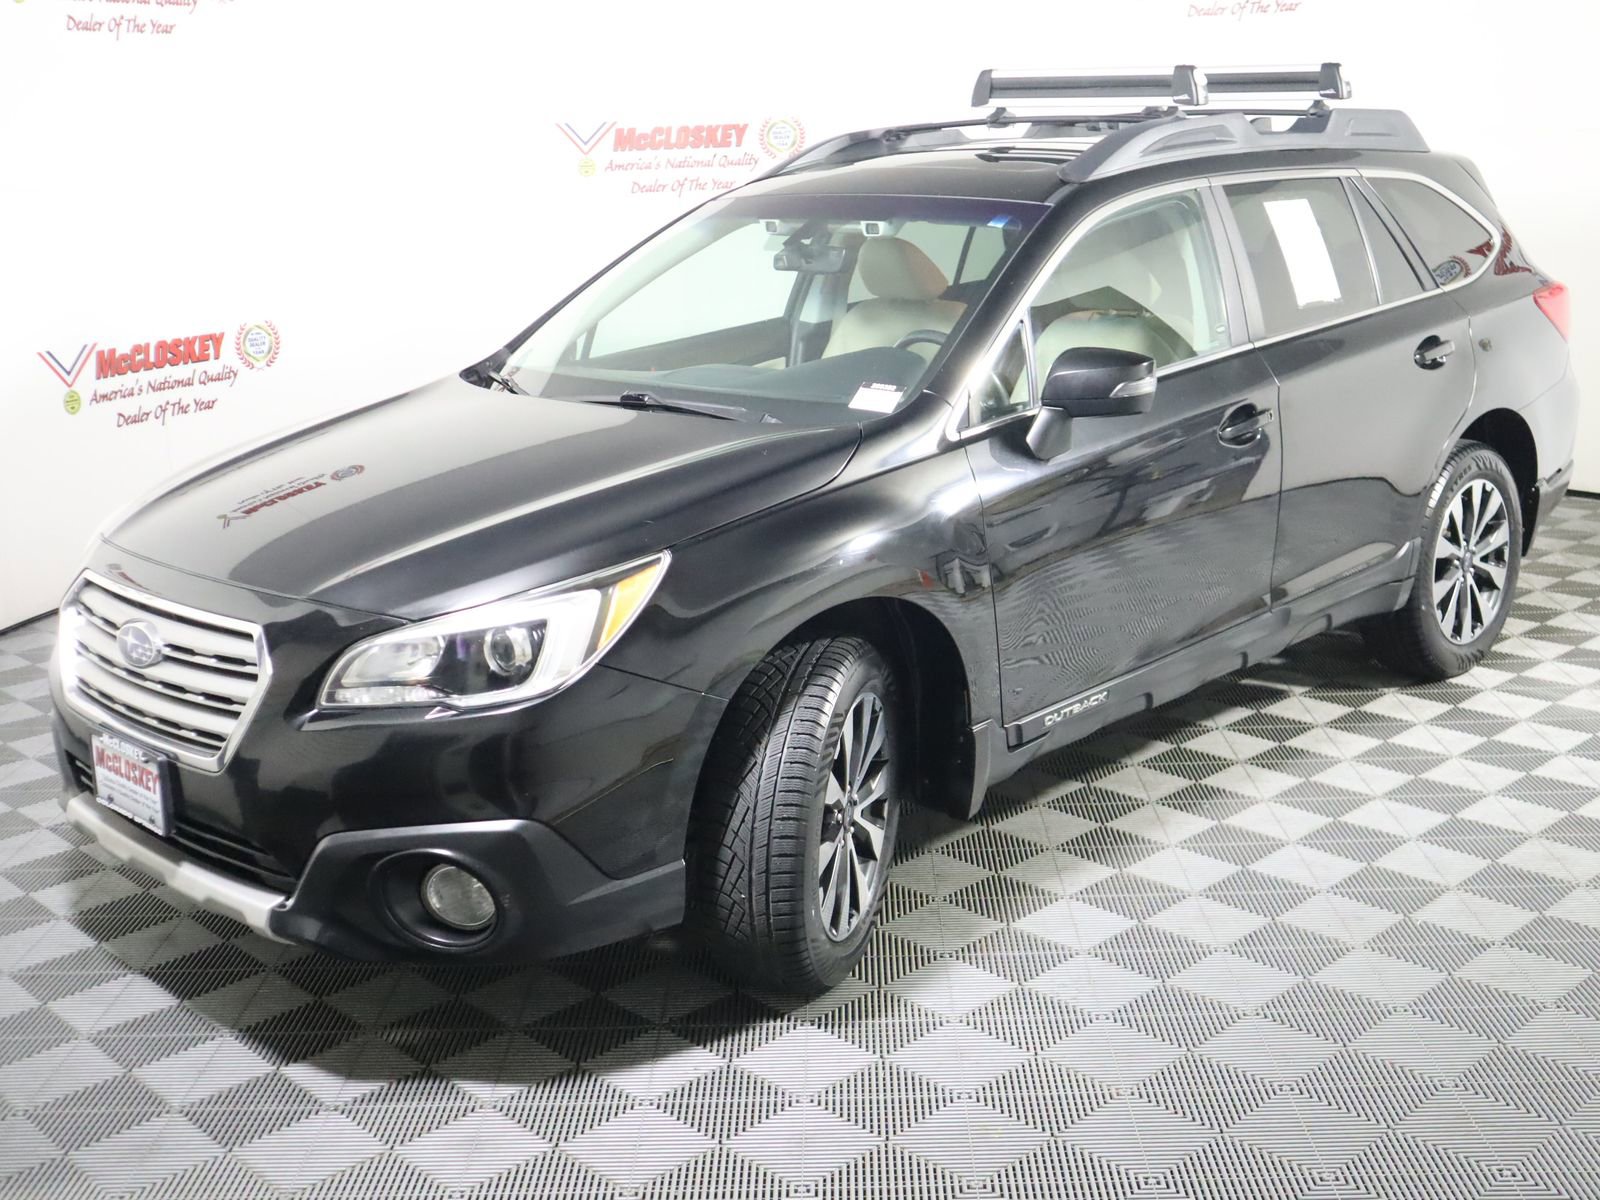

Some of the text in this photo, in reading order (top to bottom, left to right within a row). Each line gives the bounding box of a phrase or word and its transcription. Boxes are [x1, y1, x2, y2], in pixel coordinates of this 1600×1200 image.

[1187, 0, 1301, 21] Dealer Of The Year
[66, 14, 176, 41] Dealer Of The Year
[613, 123, 748, 152] McCLOSKEY
[604, 152, 759, 172] America's National Quality
[630, 177, 736, 197] Dealer Of The Year
[95, 332, 225, 380] McCLOSKEY
[89, 364, 239, 406] America's National Quality
[117, 397, 219, 428] Dealer Of The Year
[1044, 691, 1108, 726] OUTBACK
[95, 745, 160, 796] McCLOSKEY
